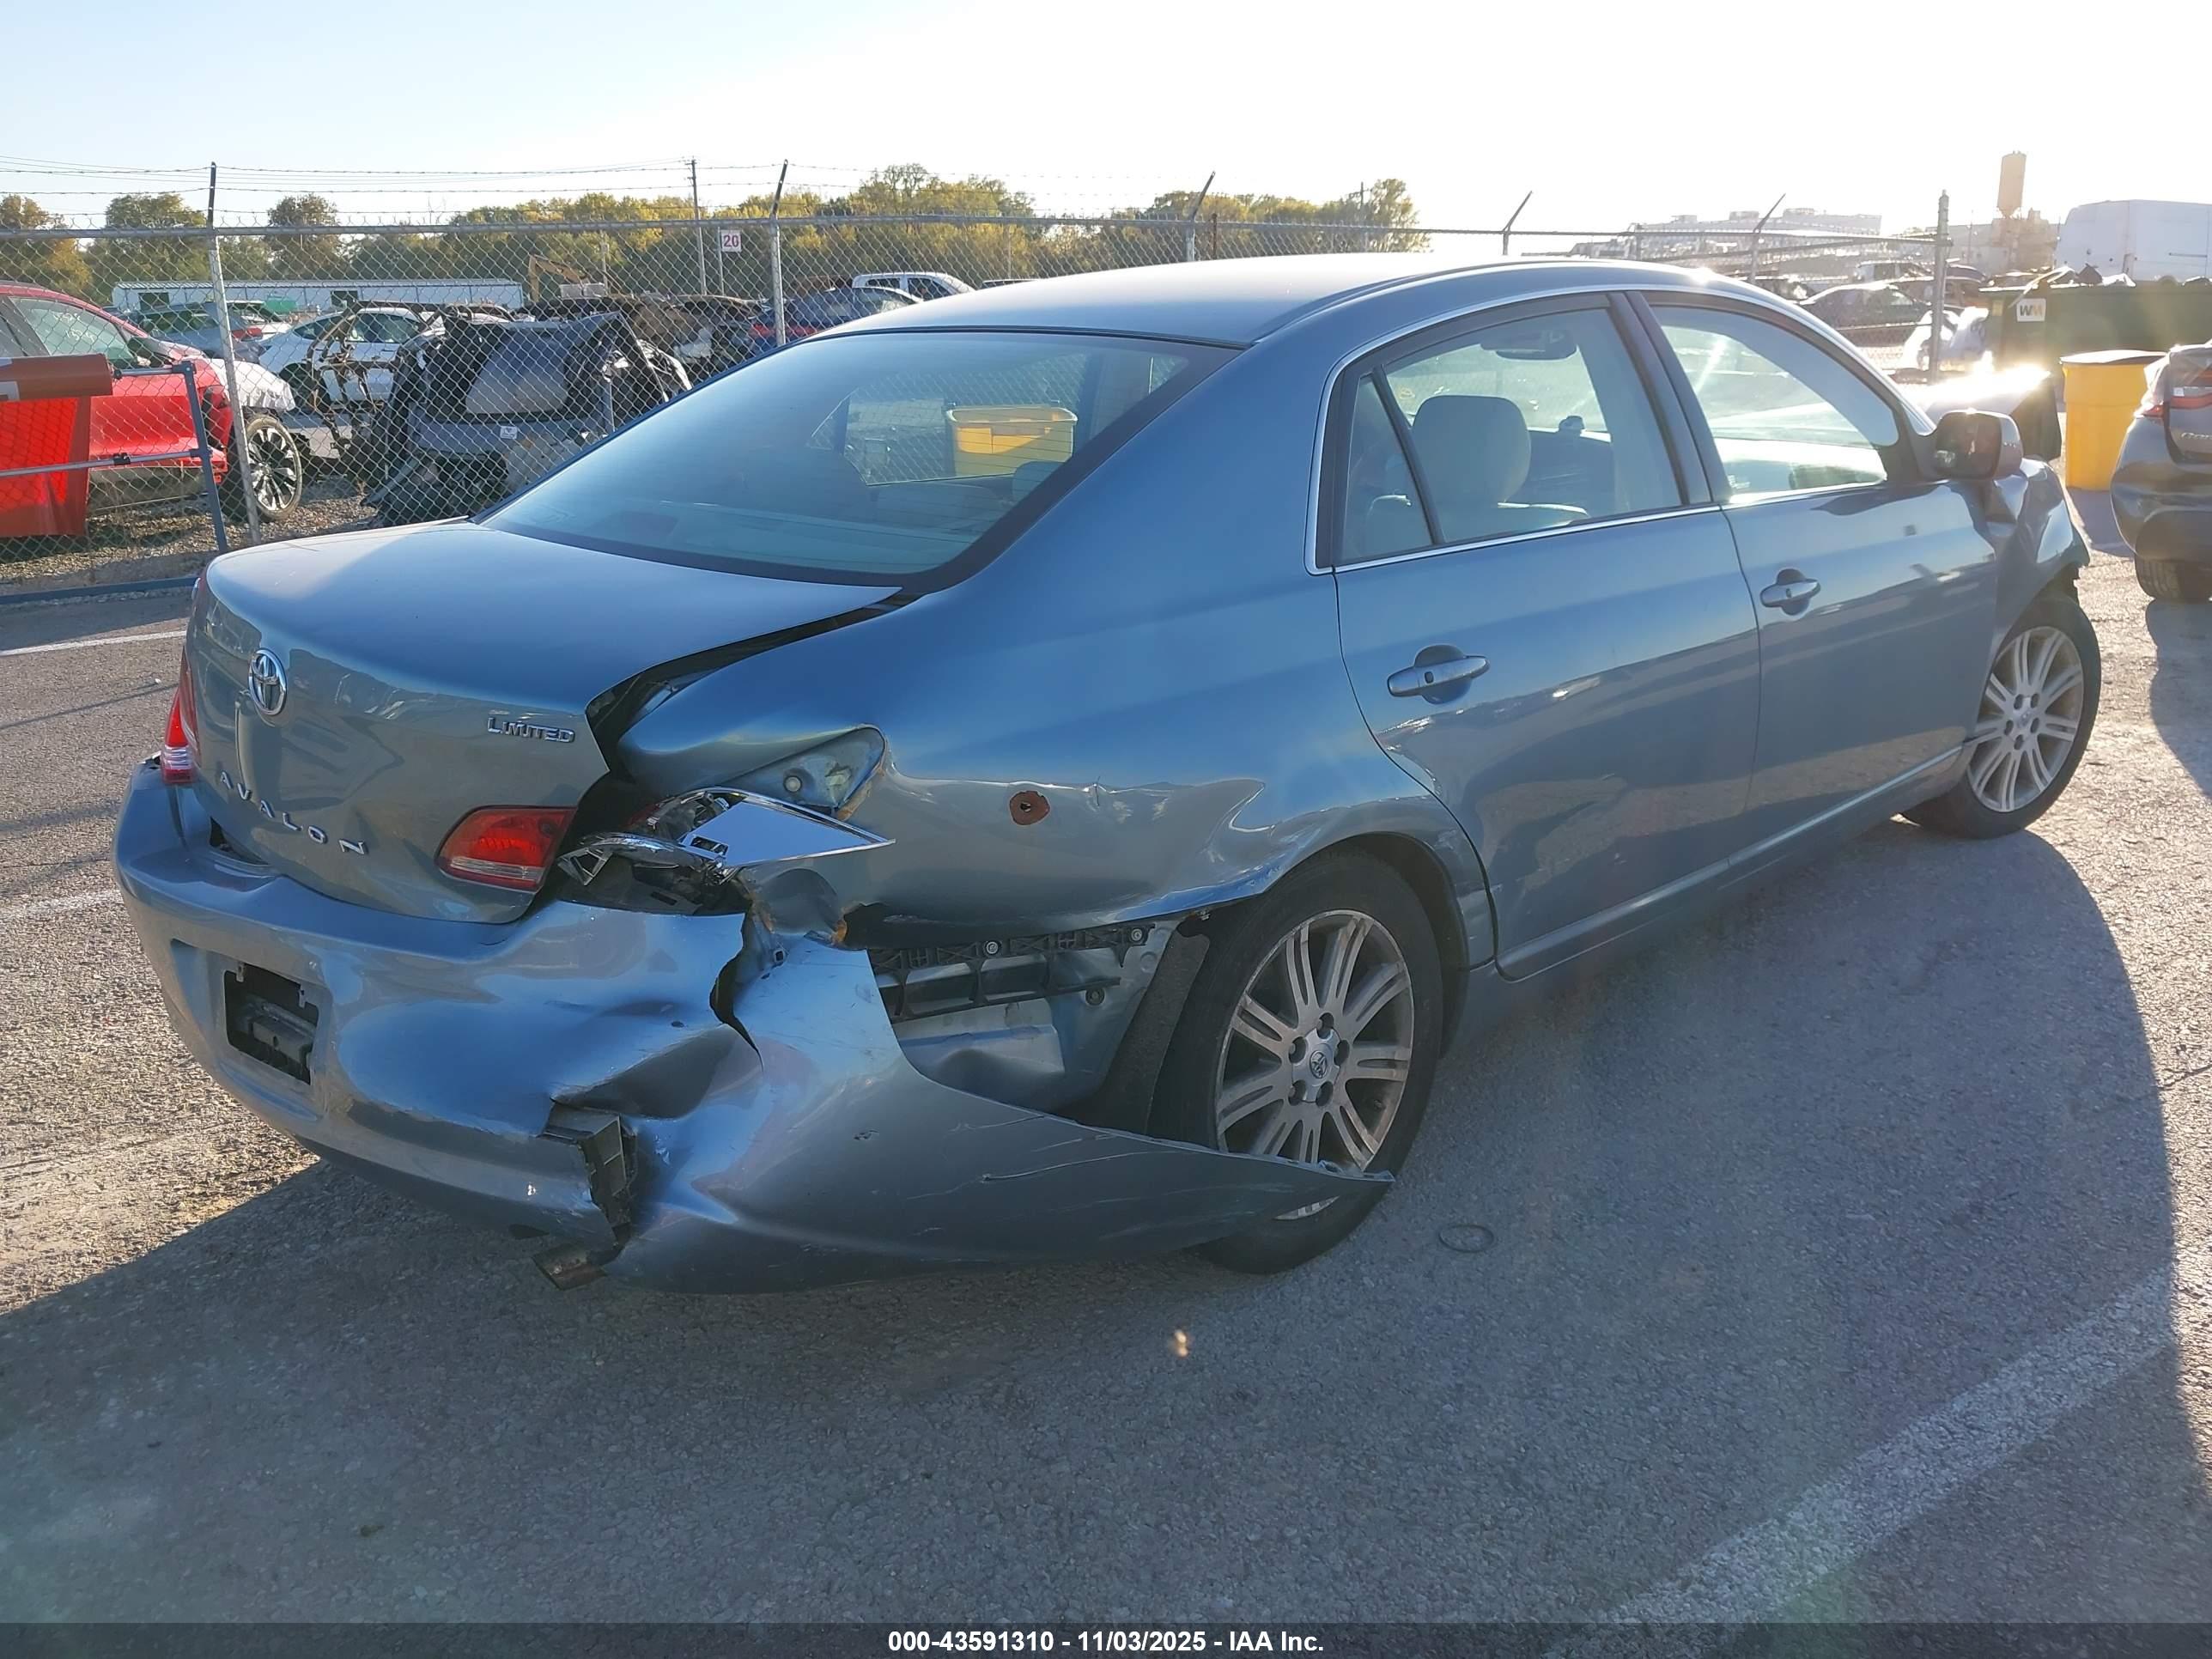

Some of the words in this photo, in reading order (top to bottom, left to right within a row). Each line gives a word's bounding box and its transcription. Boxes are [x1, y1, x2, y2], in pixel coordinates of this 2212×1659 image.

[723, 234, 739, 247] 20
[2020, 305, 2043, 316] WM
[487, 717, 575, 744] LIMITED
[220, 771, 369, 855] AVALON
